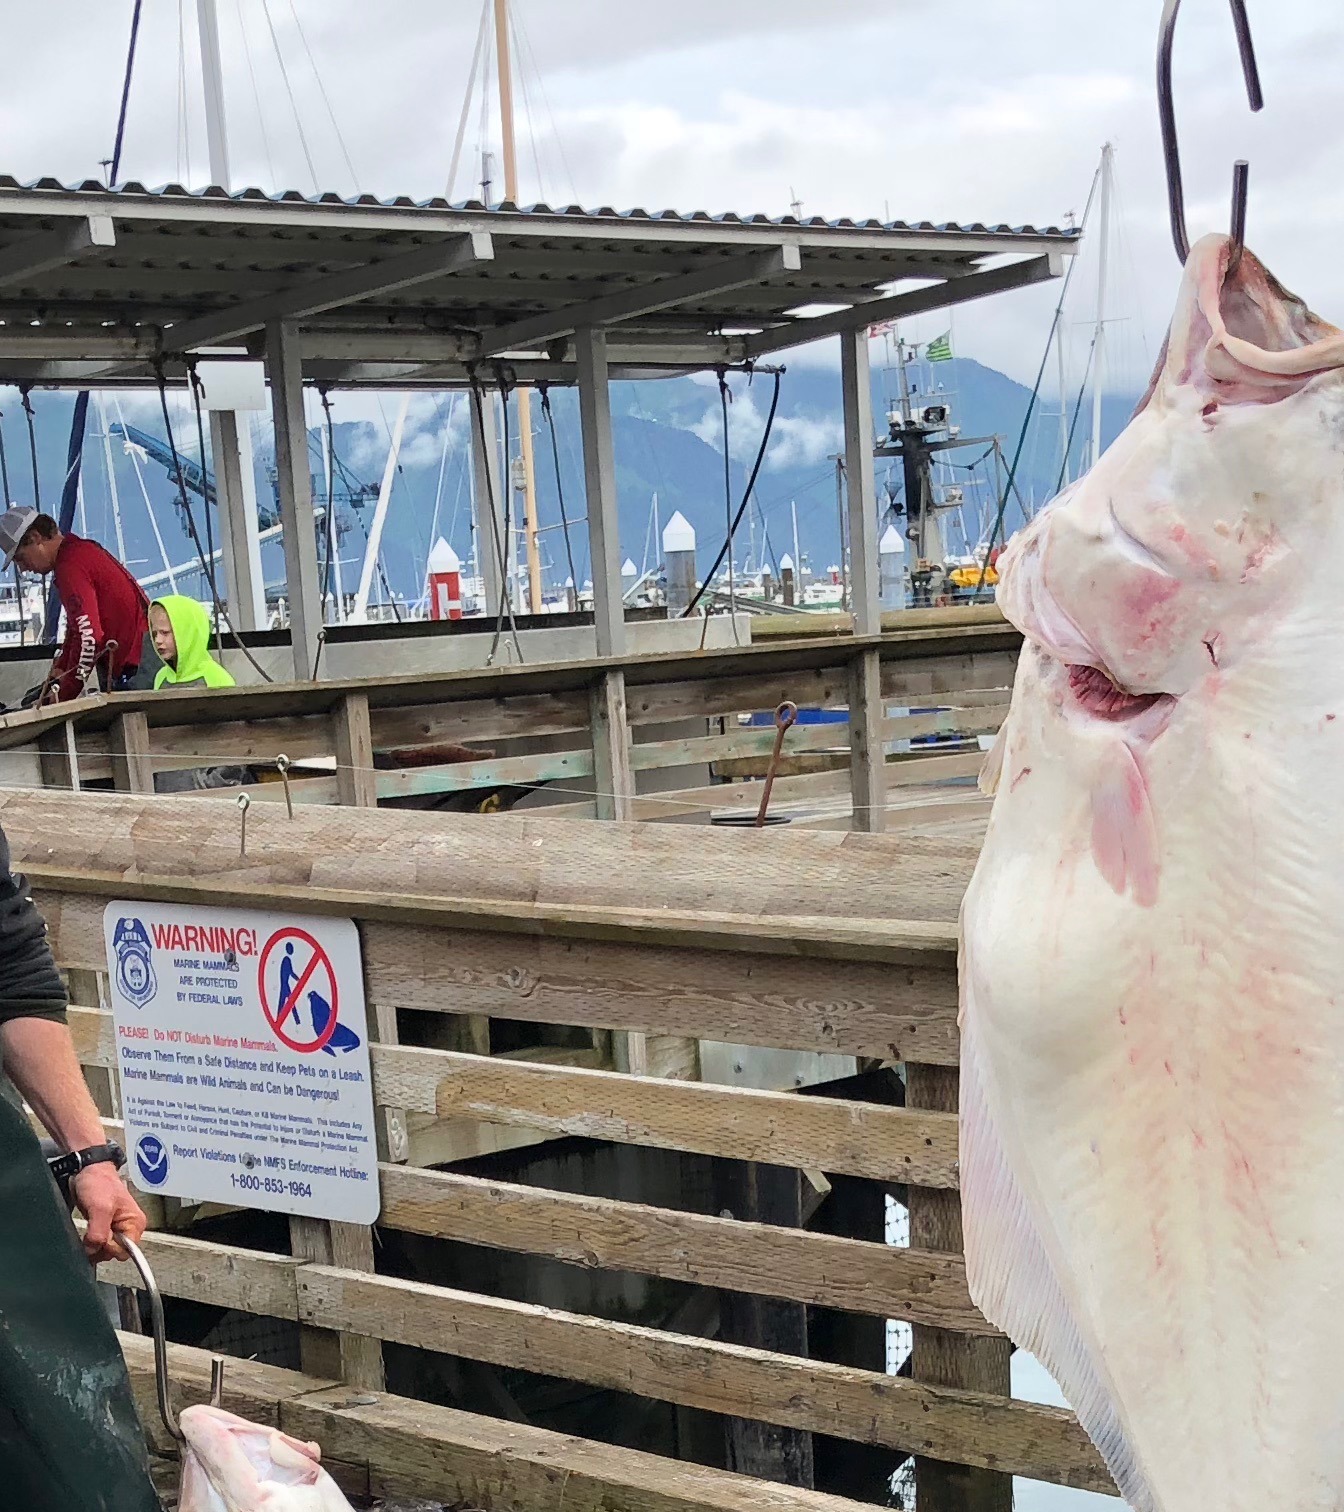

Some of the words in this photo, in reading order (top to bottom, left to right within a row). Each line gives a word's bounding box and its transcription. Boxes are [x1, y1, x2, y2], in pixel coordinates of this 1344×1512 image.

[150, 922, 259, 956] WARNING!
[173, 958, 201, 970] MARINE
[179, 975, 194, 986] ARE
[195, 976, 238, 989] PROTECTED
[176, 991, 186, 1002] BY
[188, 992, 221, 1005] FEDERAL
[222, 995, 244, 1007] LAWS
[153, 1028, 165, 1041] Do
[166, 1029, 183, 1043] NOT
[184, 1031, 212, 1045] Disturb
[213, 1034, 239, 1049] Marine
[121, 1046, 152, 1060] Observe
[153, 1049, 175, 1062] Them
[176, 1051, 196, 1064] From
[197, 1056, 203, 1065] a
[204, 1053, 223, 1067] Safe
[224, 1056, 257, 1071] Distance
[259, 1061, 274, 1073] and
[275, 1061, 297, 1077] Keep
[298, 1063, 316, 1078] Pets
[318, 1067, 329, 1078] on
[331, 1070, 337, 1080] a
[338, 1068, 365, 1082] Leash.
[123, 1066, 148, 1080] Marine
[149, 1069, 184, 1084] Mammals
[186, 1075, 198, 1086] are
[199, 1074, 217, 1087] Wild
[218, 1076, 248, 1091] Animals
[249, 1081, 264, 1093] and
[266, 1081, 282, 1095] Can
[283, 1083, 294, 1096] be
[296, 1084, 340, 1101] Dangerous!
[172, 1143, 198, 1159] Report
[199, 1147, 237, 1163] Violations
[263, 1156, 287, 1171] NMFS
[288, 1158, 338, 1177] Enforcement
[339, 1165, 369, 1181] Hotline:
[229, 1172, 313, 1199] 1-800-853-1964
